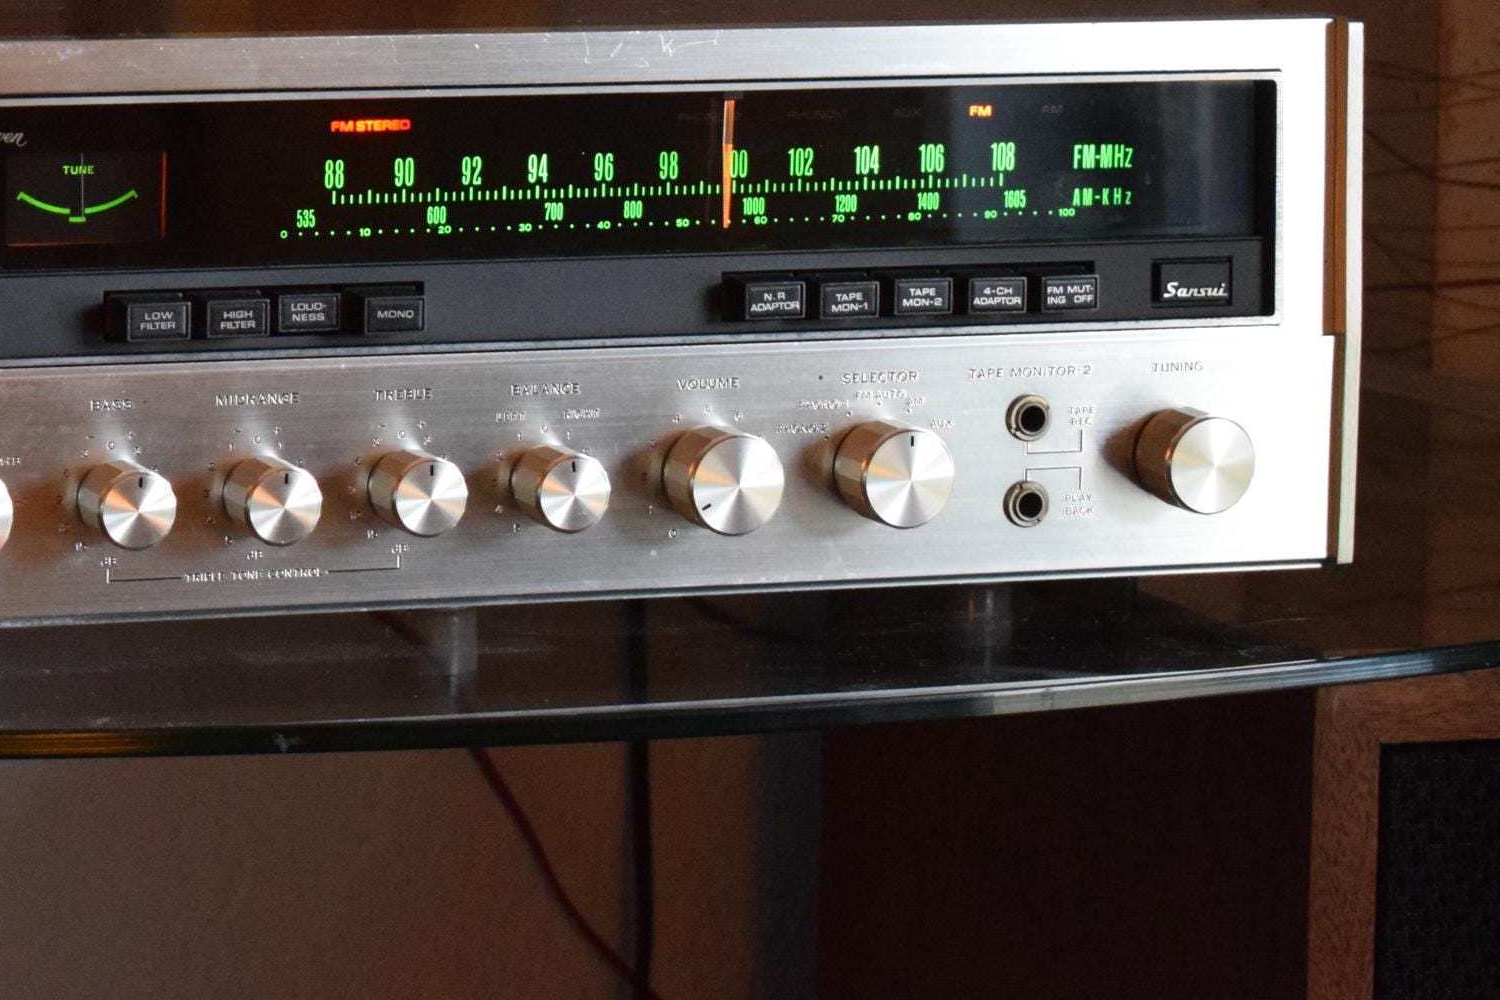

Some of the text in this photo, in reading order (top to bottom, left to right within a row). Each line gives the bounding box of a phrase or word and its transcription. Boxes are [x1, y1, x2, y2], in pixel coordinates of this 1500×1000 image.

[969, 104, 992, 117] FM
[330, 119, 411, 132] FM STEREO
[62, 165, 95, 175] TUNE
[324, 142, 1133, 189] 88 90 92 94 96 98 00 102 104 106 108 FM-MHz
[296, 189, 1026, 228] 535 600 700 800 1000 1200 1400 1605
[280, 208, 1076, 238] 0 10 20 30 40 50 60 70 80 90 100
[909, 288, 936, 296] TAPE
[983, 287, 1013, 295] 4-CH
[1067, 285, 1094, 294] MUT-
[1163, 281, 1228, 299] Sansui
[835, 292, 863, 302] TAPE
[973, 296, 1022, 306] ADAPTOR
[1047, 294, 1093, 304] ING OFF
[291, 302, 327, 312] LOUD-
[750, 301, 800, 312] ADAPTOR
[831, 303, 868, 312] MON-1
[903, 298, 942, 307] MON-2
[144, 311, 174, 320] LOW
[223, 309, 253, 319] HIGH
[292, 312, 325, 322] NESS
[377, 309, 414, 319] MONO
[140, 321, 176, 331] FILTER
[221, 320, 256, 329] FILTER
[968, 365, 1092, 380] TAPE MONITOR-2
[1151, 361, 1204, 374] TUNING
[840, 370, 919, 386] SELECTOR
[677, 377, 740, 391] VOLUME
[373, 388, 433, 401] TREBLE
[510, 382, 581, 397] BALANCE
[215, 392, 300, 407] MIDRANGE
[90, 399, 133, 412] BASS
